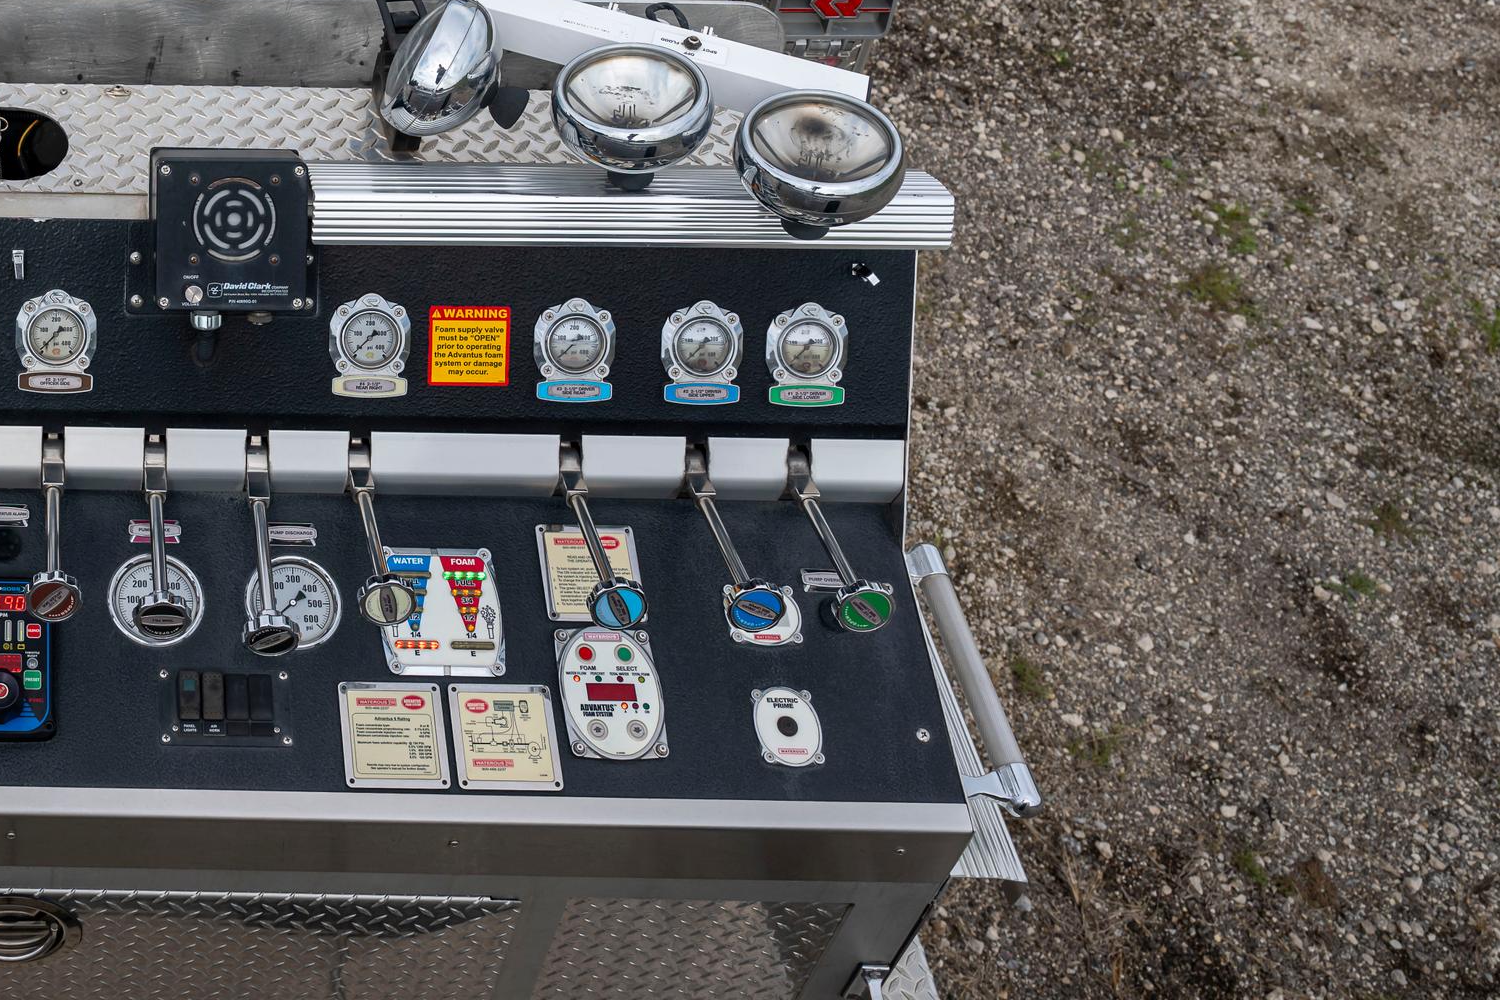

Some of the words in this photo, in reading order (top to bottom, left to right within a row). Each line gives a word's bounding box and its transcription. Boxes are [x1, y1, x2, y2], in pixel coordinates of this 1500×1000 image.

[223, 282, 247, 290] David
[247, 282, 271, 290] Clark
[443, 308, 508, 319] WARNING
[435, 325, 456, 333] Foam
[457, 326, 483, 334] supply
[436, 343, 455, 351] prior
[465, 343, 501, 351] operating
[434, 360, 462, 368] system
[473, 360, 503, 368] damage
[393, 557, 424, 565] WATER
[285, 574, 301, 583] 300
[132, 580, 148, 588] 200
[302, 584, 317, 593] 400
[307, 600, 323, 608] 500
[303, 614, 319, 623] 600
